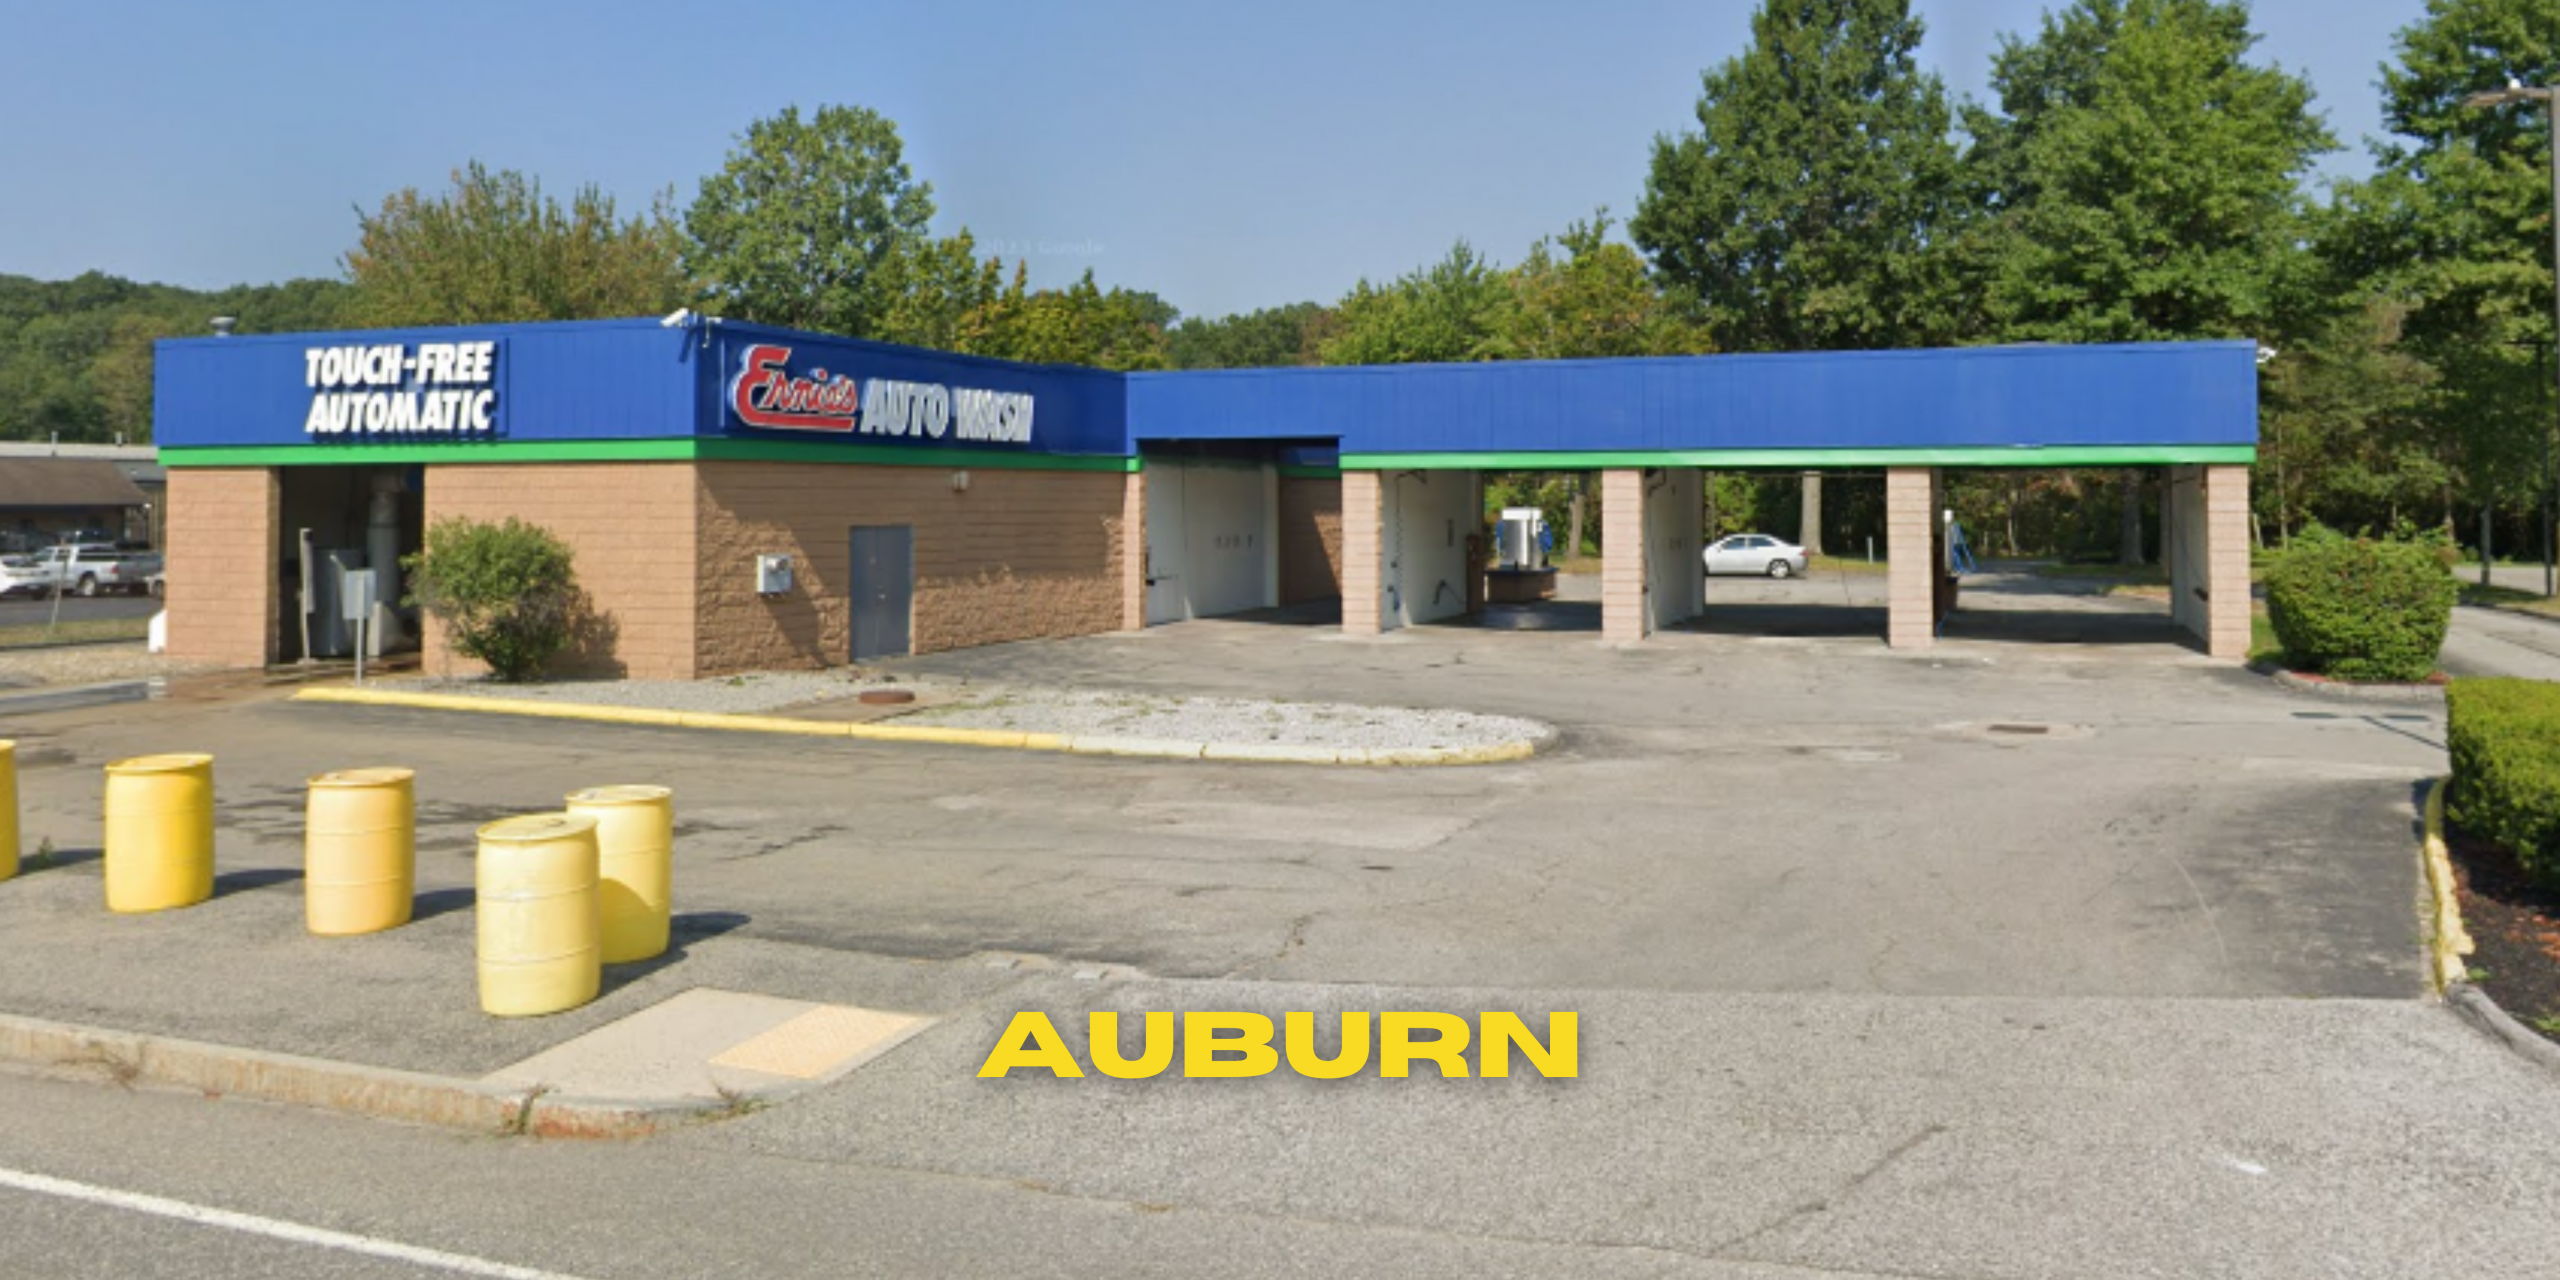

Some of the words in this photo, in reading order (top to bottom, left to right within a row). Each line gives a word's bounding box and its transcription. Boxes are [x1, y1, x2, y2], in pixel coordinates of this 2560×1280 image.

[305, 341, 495, 387] TOUCH-FREE
[304, 388, 494, 433] AUTOMATIC
[730, 344, 858, 431] Ernie's
[860, 378, 949, 438] AUTO
[951, 386, 1034, 443] WASH
